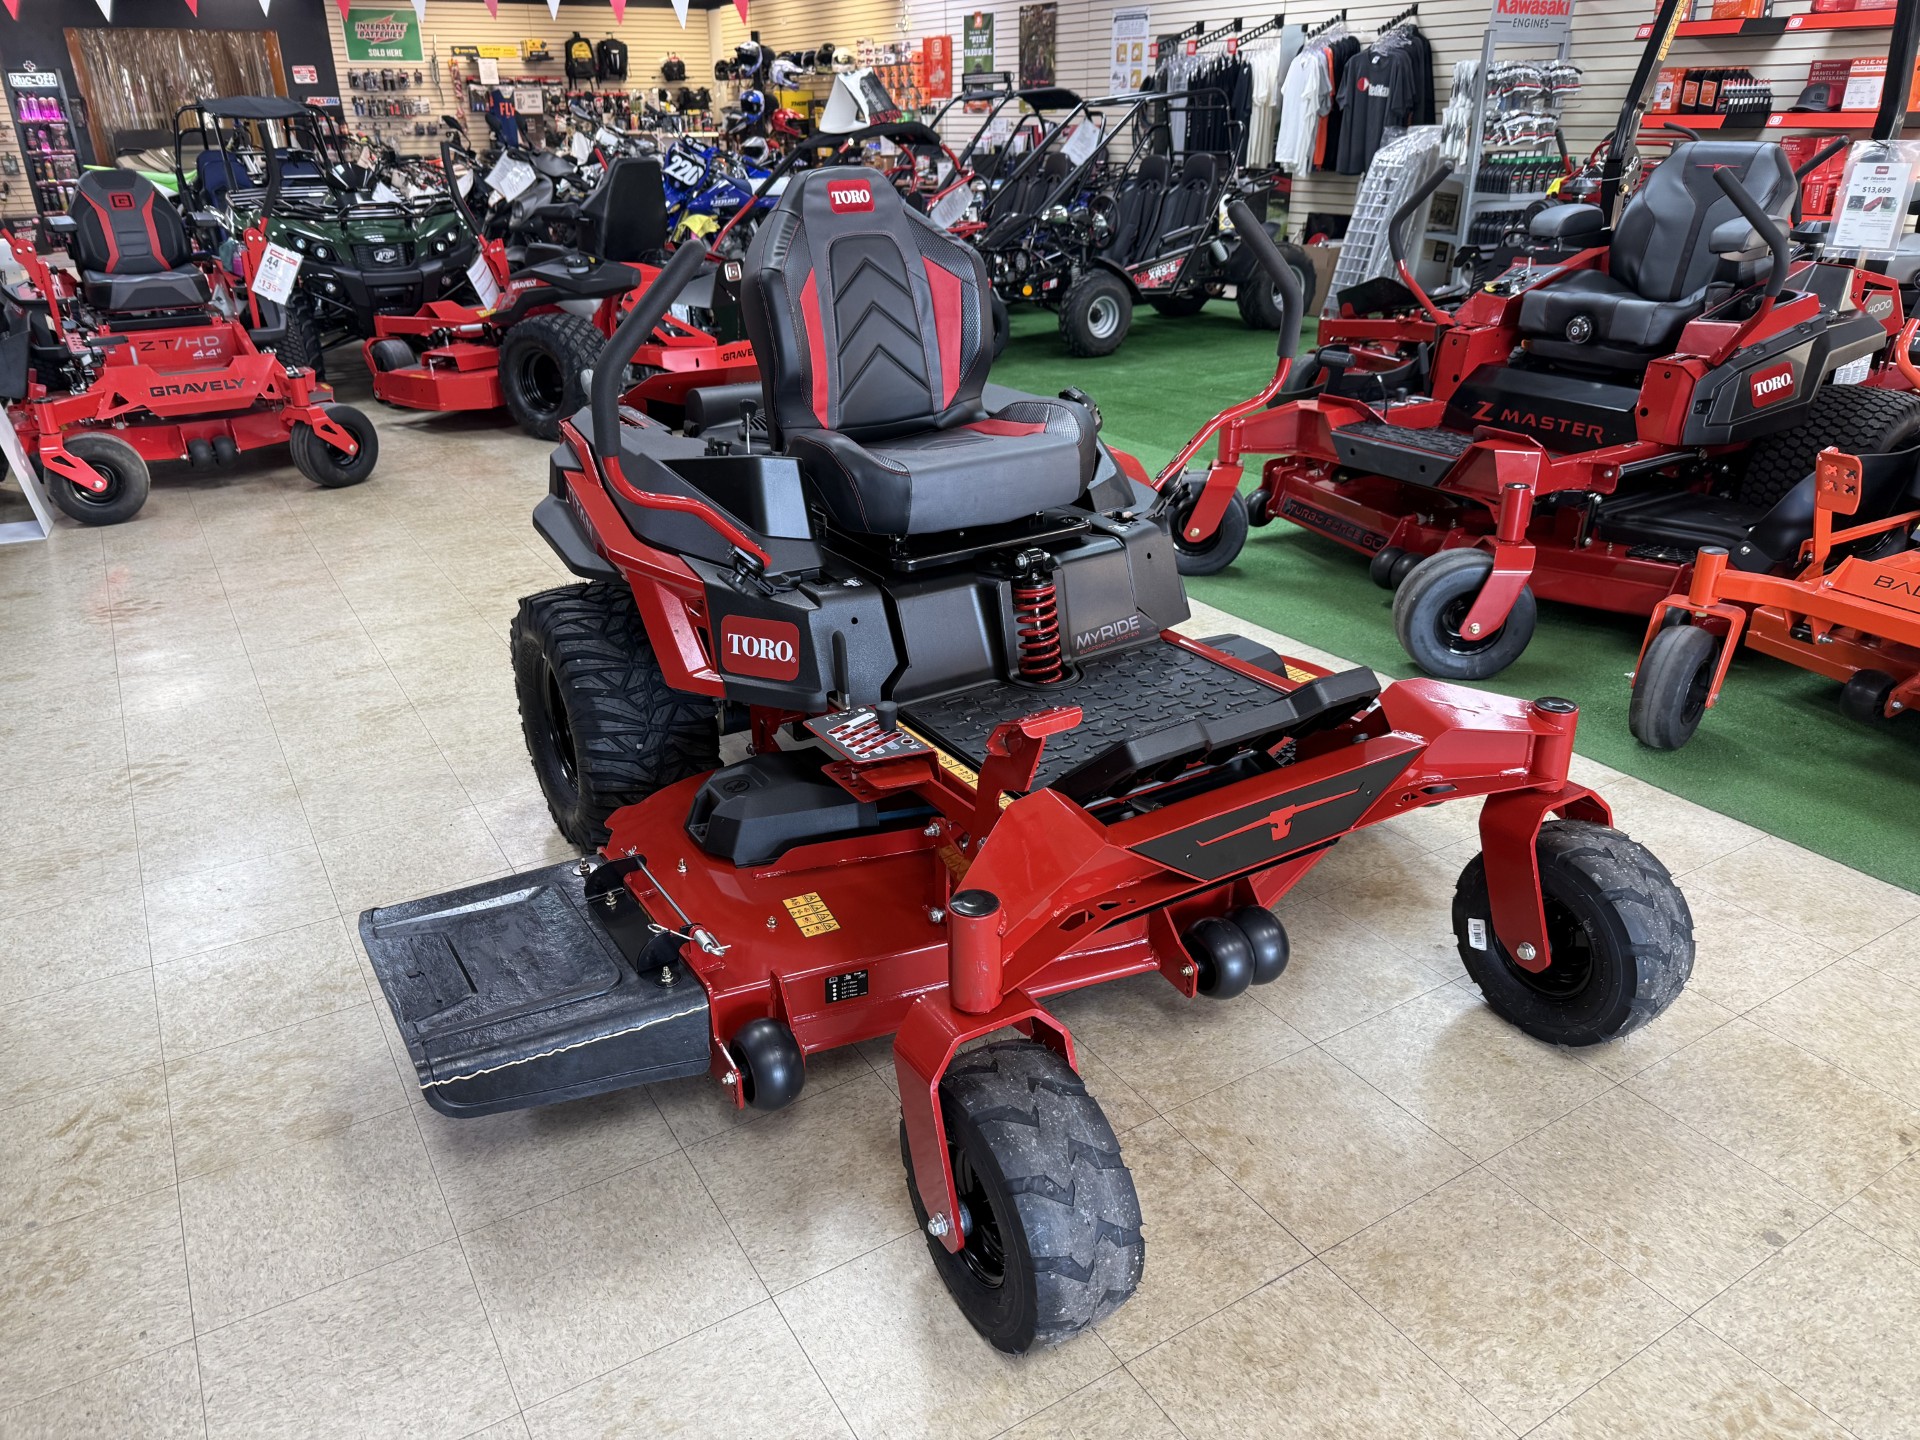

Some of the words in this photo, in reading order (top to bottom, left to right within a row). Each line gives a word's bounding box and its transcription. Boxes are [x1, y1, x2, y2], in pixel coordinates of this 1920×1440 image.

[1497, 0, 1571, 16] Kawasaki
[356, 23, 406, 31] INTERSTATE
[1512, 18, 1550, 29] ENGINES
[359, 30, 404, 39] BATTERIES
[368, 48, 386, 57] SOLD
[387, 49, 404, 57] HERE
[11, 74, 57, 86] Muc-Off
[307, 97, 340, 106] AMSOIL
[499, 102, 516, 117] FLY
[664, 155, 705, 186] 220
[831, 189, 871, 205] TORO
[1862, 186, 1892, 194] $13,699
[511, 279, 537, 290] GRAVELY
[1867, 299, 1892, 315] 4000
[722, 348, 754, 362] GRAVE
[149, 377, 246, 397] GRAVELY
[1753, 370, 1792, 399] TORO
[1470, 401, 1496, 422] Z
[1500, 408, 1605, 445] MASTER
[1289, 503, 1324, 524] TURBO
[1324, 518, 1362, 540] FORCE
[727, 632, 794, 663] TORO
[1079, 640, 1116, 655] SUSPENSION
[1116, 630, 1140, 642] SYSTEM
